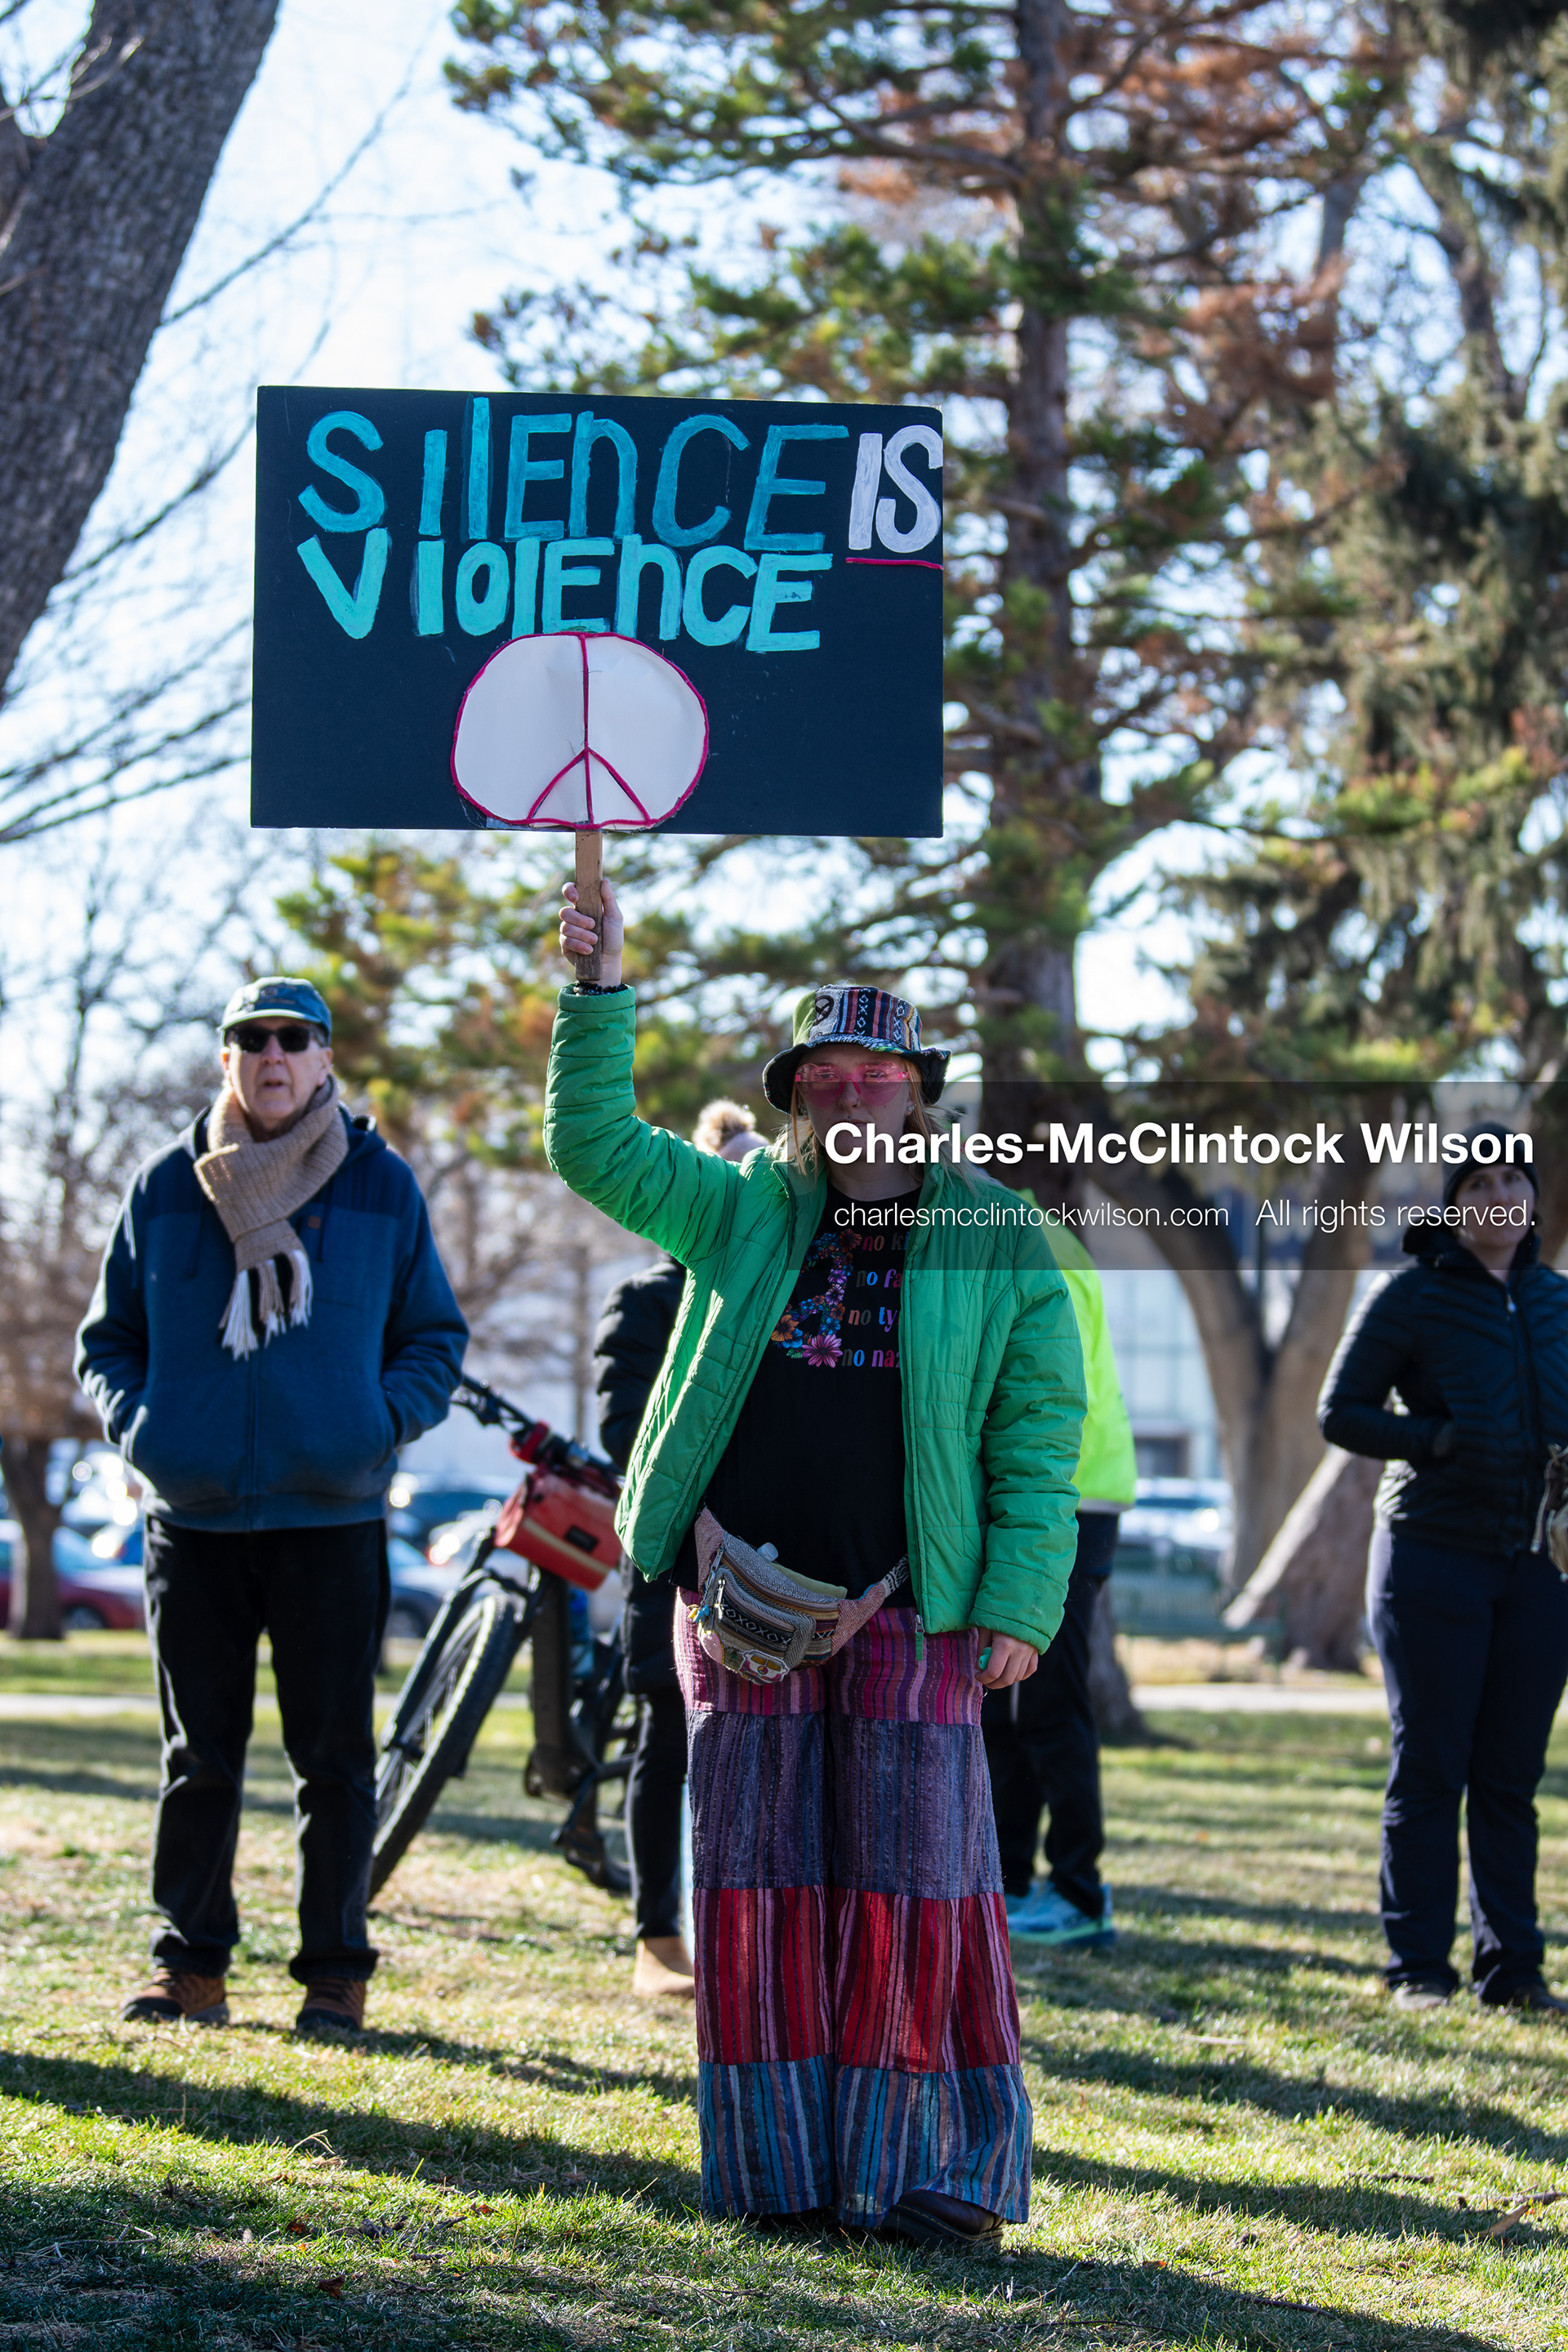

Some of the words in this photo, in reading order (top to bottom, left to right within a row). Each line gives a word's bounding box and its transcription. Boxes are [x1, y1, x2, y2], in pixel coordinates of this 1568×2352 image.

[849, 425, 943, 553] IS
[862, 1235, 885, 1251] no
[856, 1269, 879, 1288] no
[884, 1268, 902, 1288] fa
[848, 1309, 872, 1325] no
[878, 1307, 901, 1333] ty
[841, 1348, 866, 1367] no
